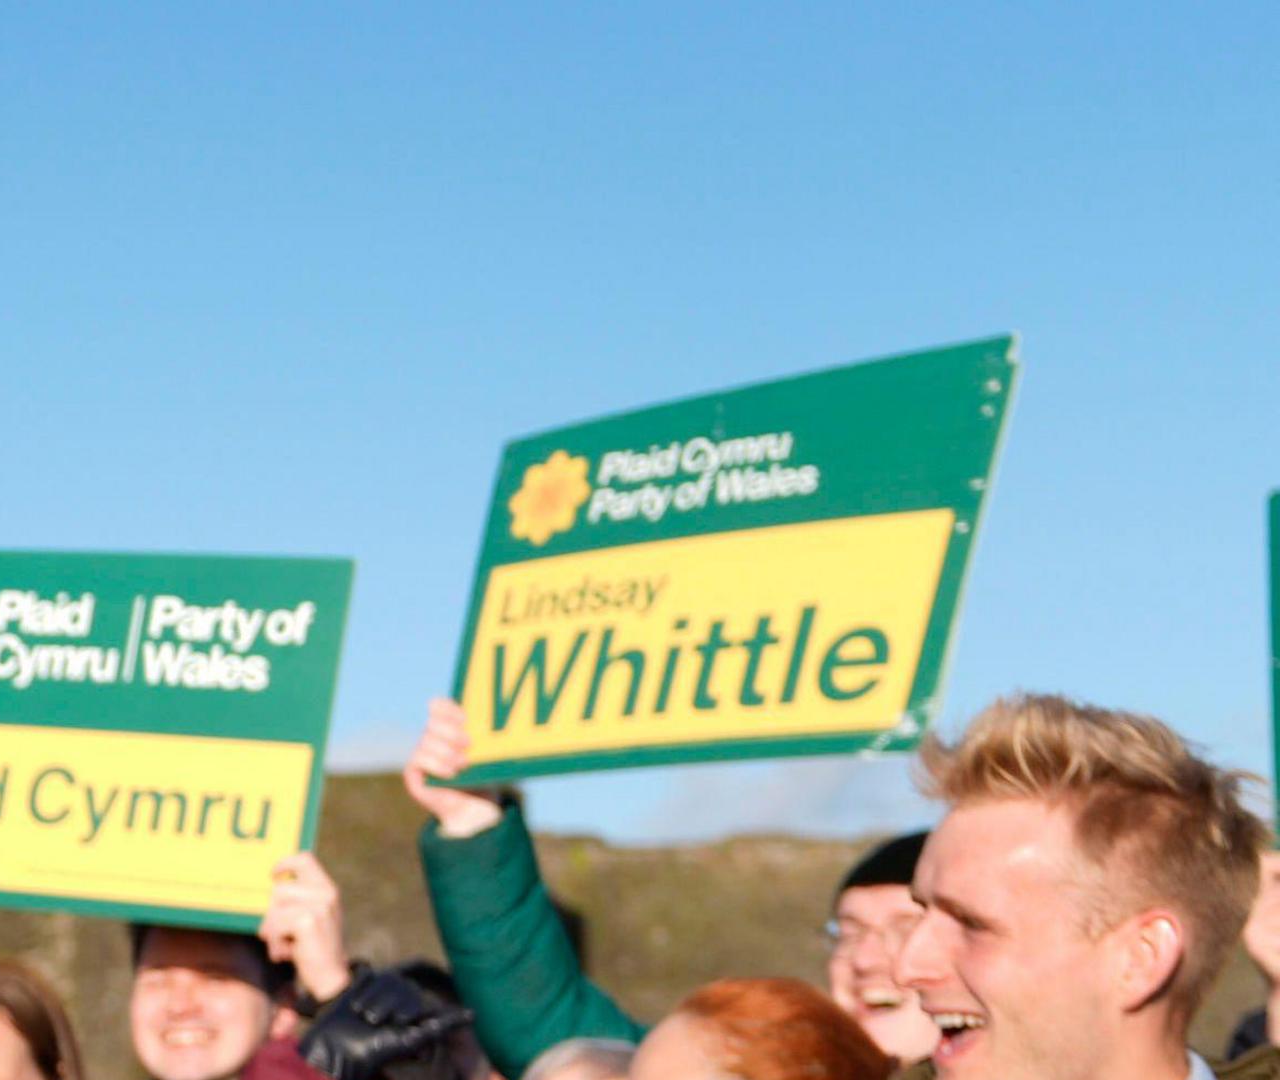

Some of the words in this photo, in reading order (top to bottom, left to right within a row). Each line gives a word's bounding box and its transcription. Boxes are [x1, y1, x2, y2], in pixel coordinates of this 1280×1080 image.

[597, 442, 681, 485] Plaid
[681, 431, 794, 473] Cymru
[587, 482, 675, 523] Party
[675, 471, 712, 511] of
[715, 464, 819, 505] Wales
[148, 594, 265, 652] Party
[265, 600, 316, 647] of
[499, 573, 668, 627] Lindsay
[143, 642, 270, 692] Wales
[491, 605, 890, 732] Whittle
[28, 766, 272, 845] Cymru
